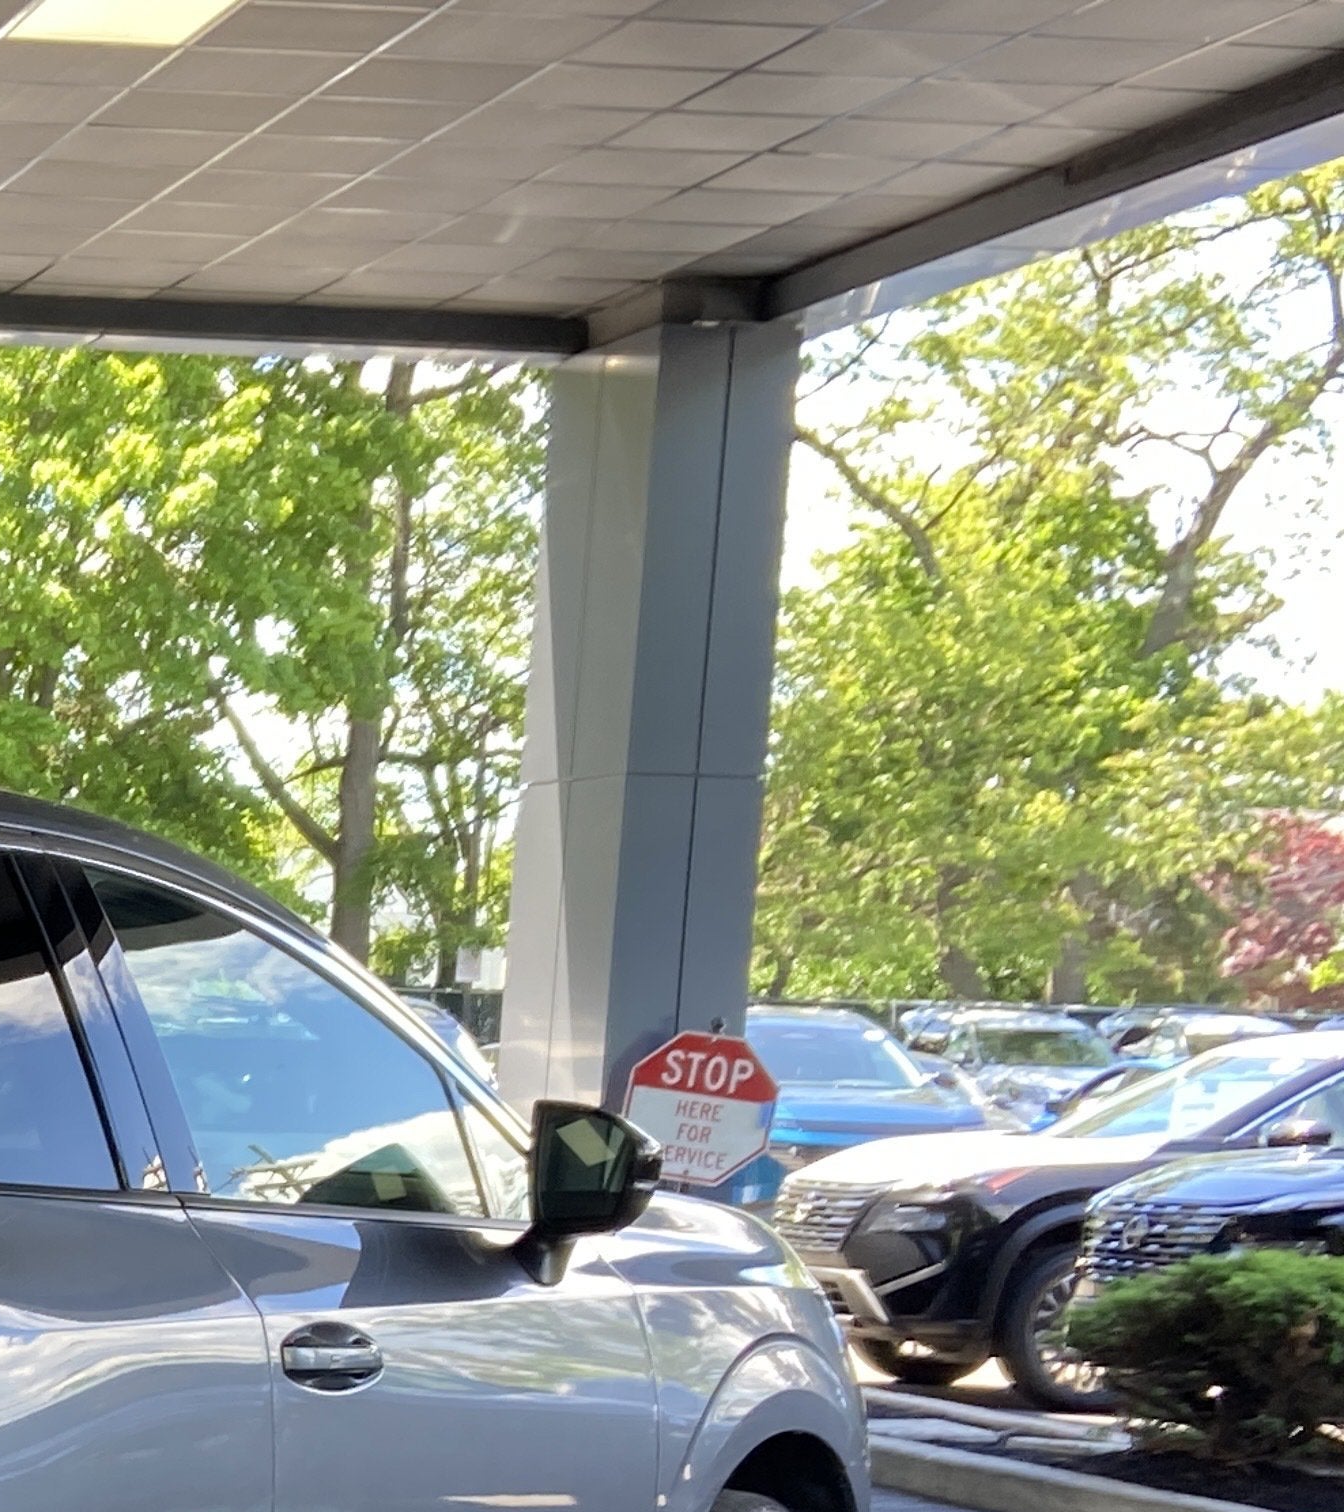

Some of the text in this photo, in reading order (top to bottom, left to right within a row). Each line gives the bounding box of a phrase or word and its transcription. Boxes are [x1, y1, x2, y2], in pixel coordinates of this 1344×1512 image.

[661, 1049, 754, 1094] STOP
[675, 1100, 724, 1122] HERE
[676, 1123, 712, 1143] FOR
[662, 1144, 727, 1170] ERVICE
